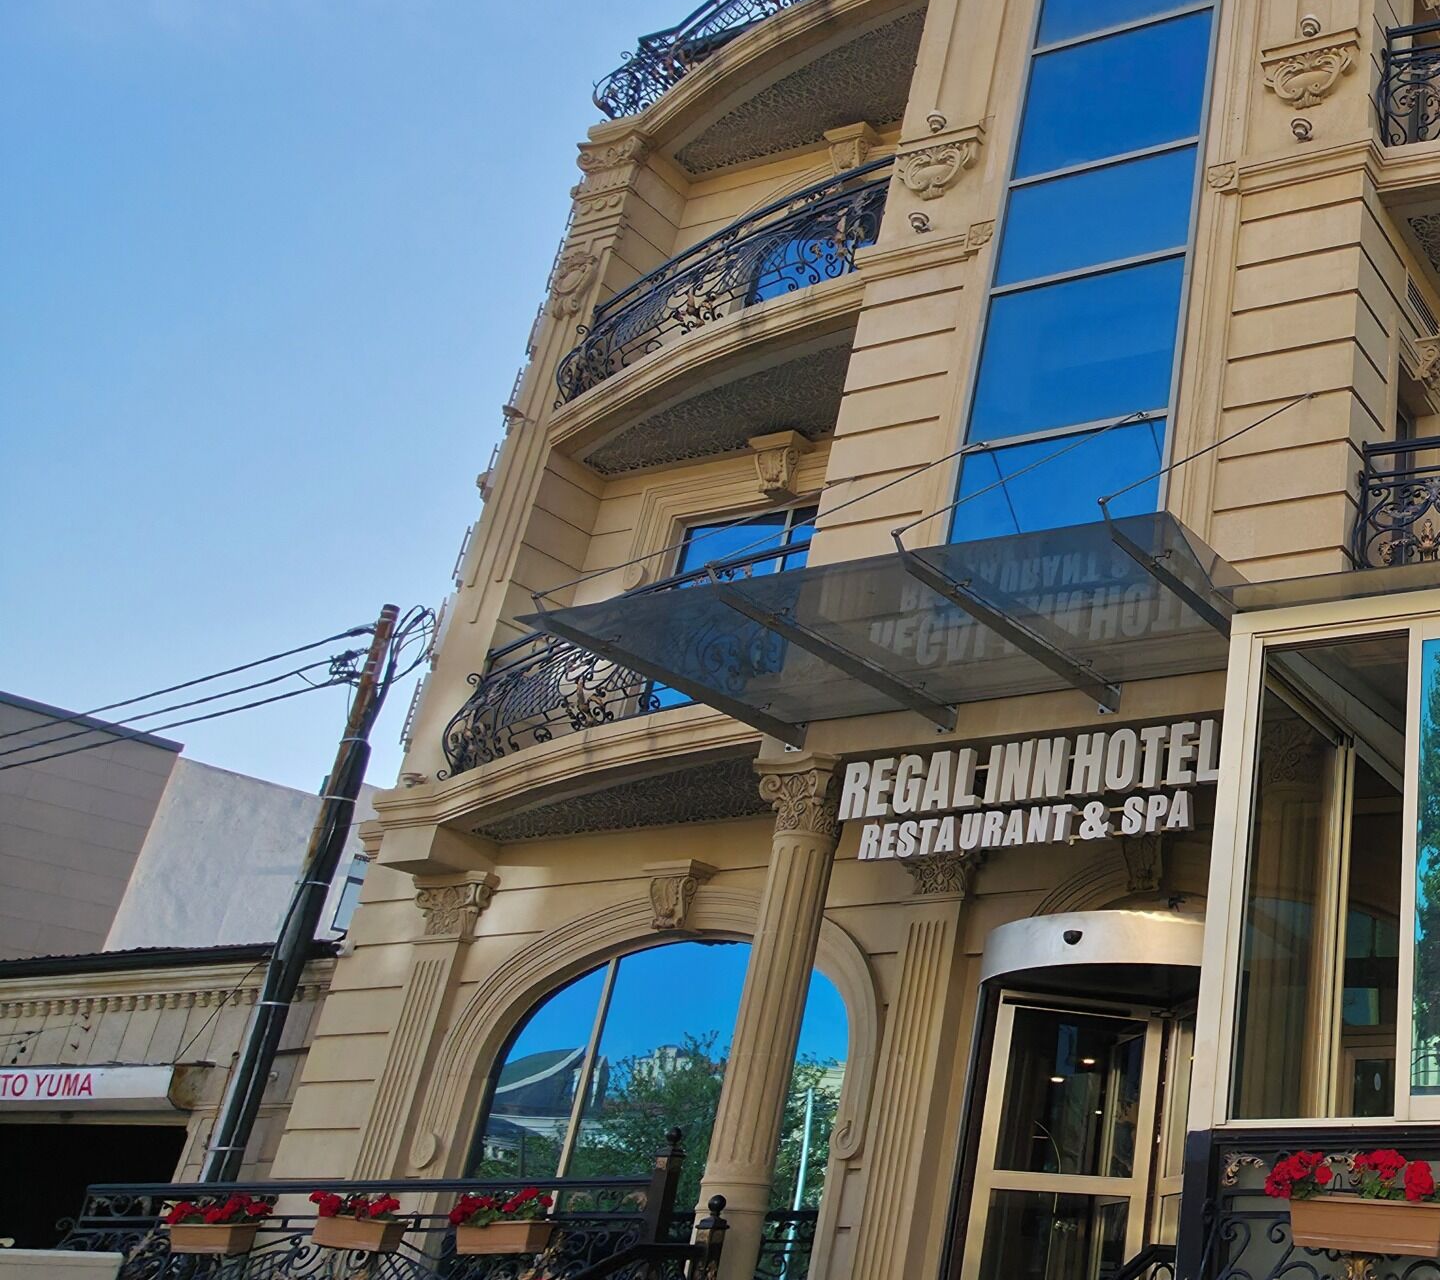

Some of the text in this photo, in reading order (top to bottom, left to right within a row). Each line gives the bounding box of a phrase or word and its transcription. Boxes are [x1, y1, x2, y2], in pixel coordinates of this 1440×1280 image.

[837, 719, 1220, 820] REGAL INN HOTEL
[858, 790, 1194, 860] RESTAURANT & SPA
[36, 1073, 92, 1097] YUMA
